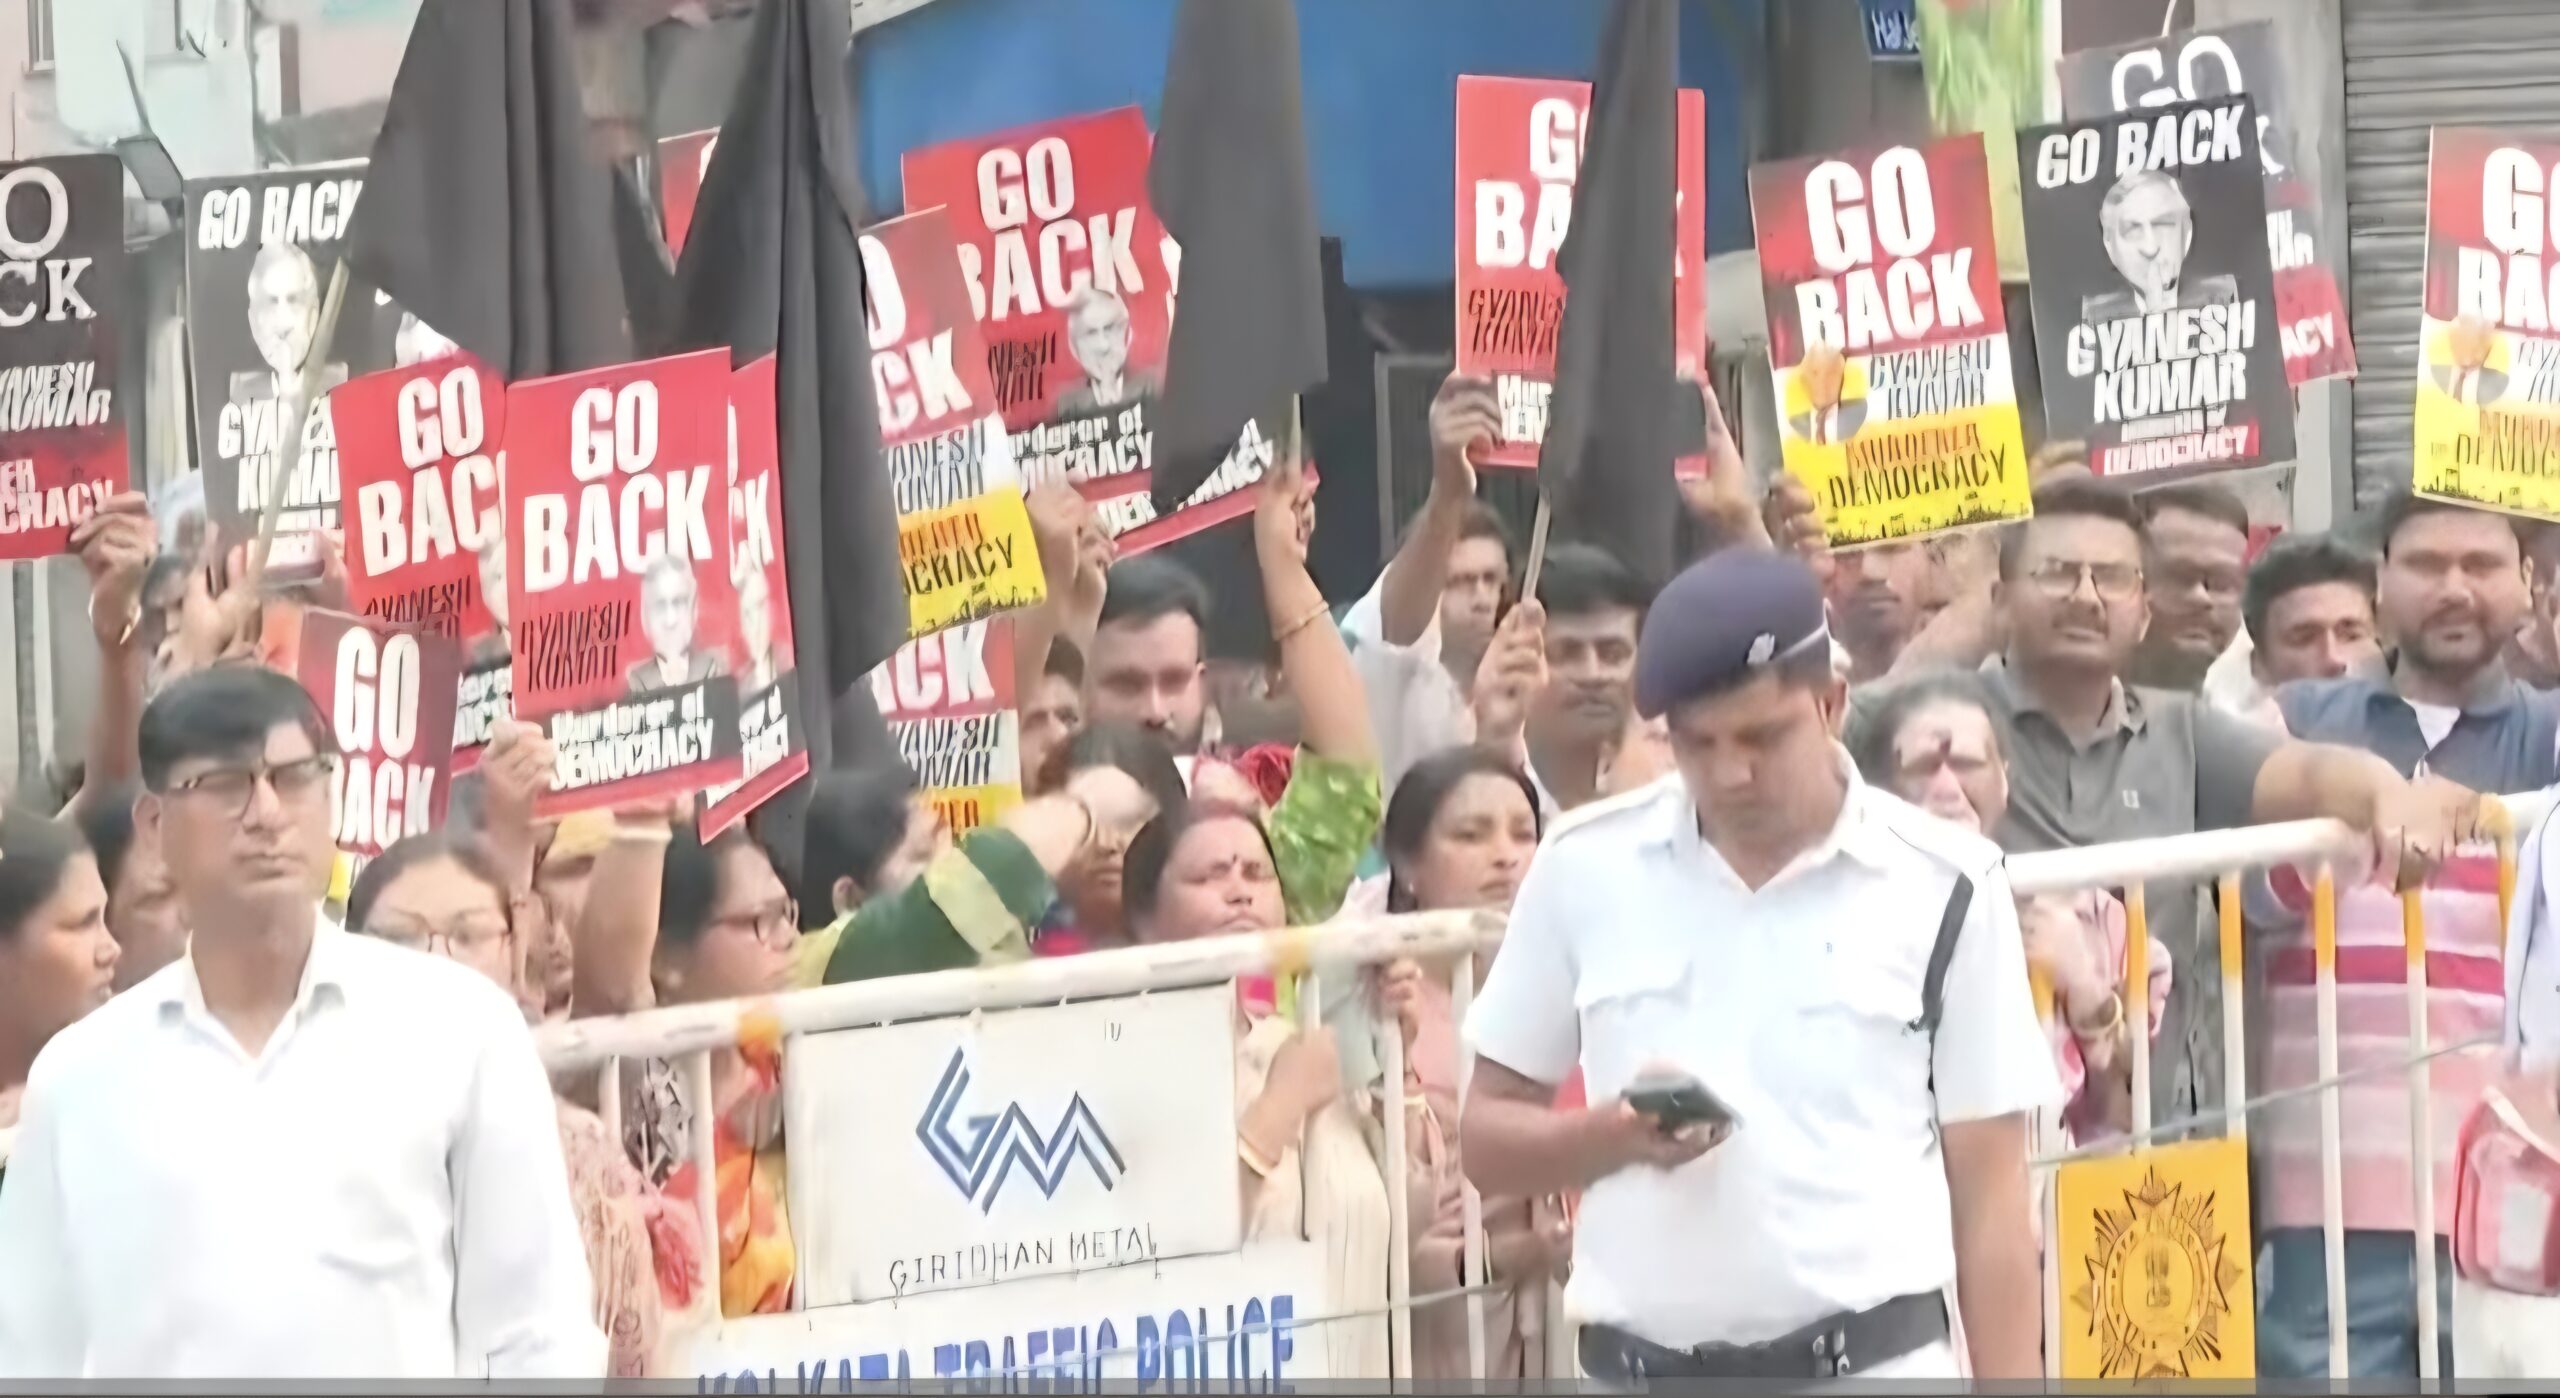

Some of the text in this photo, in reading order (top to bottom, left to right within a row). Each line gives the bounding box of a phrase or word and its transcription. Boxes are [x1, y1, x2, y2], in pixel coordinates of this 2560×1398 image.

[2111, 36, 2242, 112] GO
[977, 137, 1074, 232] GO
[1530, 98, 1591, 184] G
[2036, 128, 2100, 189] GO
[2115, 104, 2245, 177] BACK
[0, 166, 68, 259] O
[200, 187, 250, 250] GO
[1475, 178, 1573, 270] BA
[1805, 145, 1936, 274] GO
[2482, 147, 2560, 257] G
[0, 256, 97, 327] CK
[1795, 246, 1985, 352] BACK
[2457, 245, 2560, 329] BA
[870, 326, 974, 430] CK
[2067, 298, 2255, 378] GYANESH
[397, 365, 484, 470] GO
[571, 379, 659, 482] GO
[2094, 350, 2247, 424] KUMAR
[358, 453, 507, 577] BAC
[1829, 443, 2005, 508] DEMOCRACY
[523, 463, 713, 593] BACK
[333, 626, 421, 758] GO
[330, 756, 437, 850] ACK
[1136, 1295, 1296, 1395] POLICE
